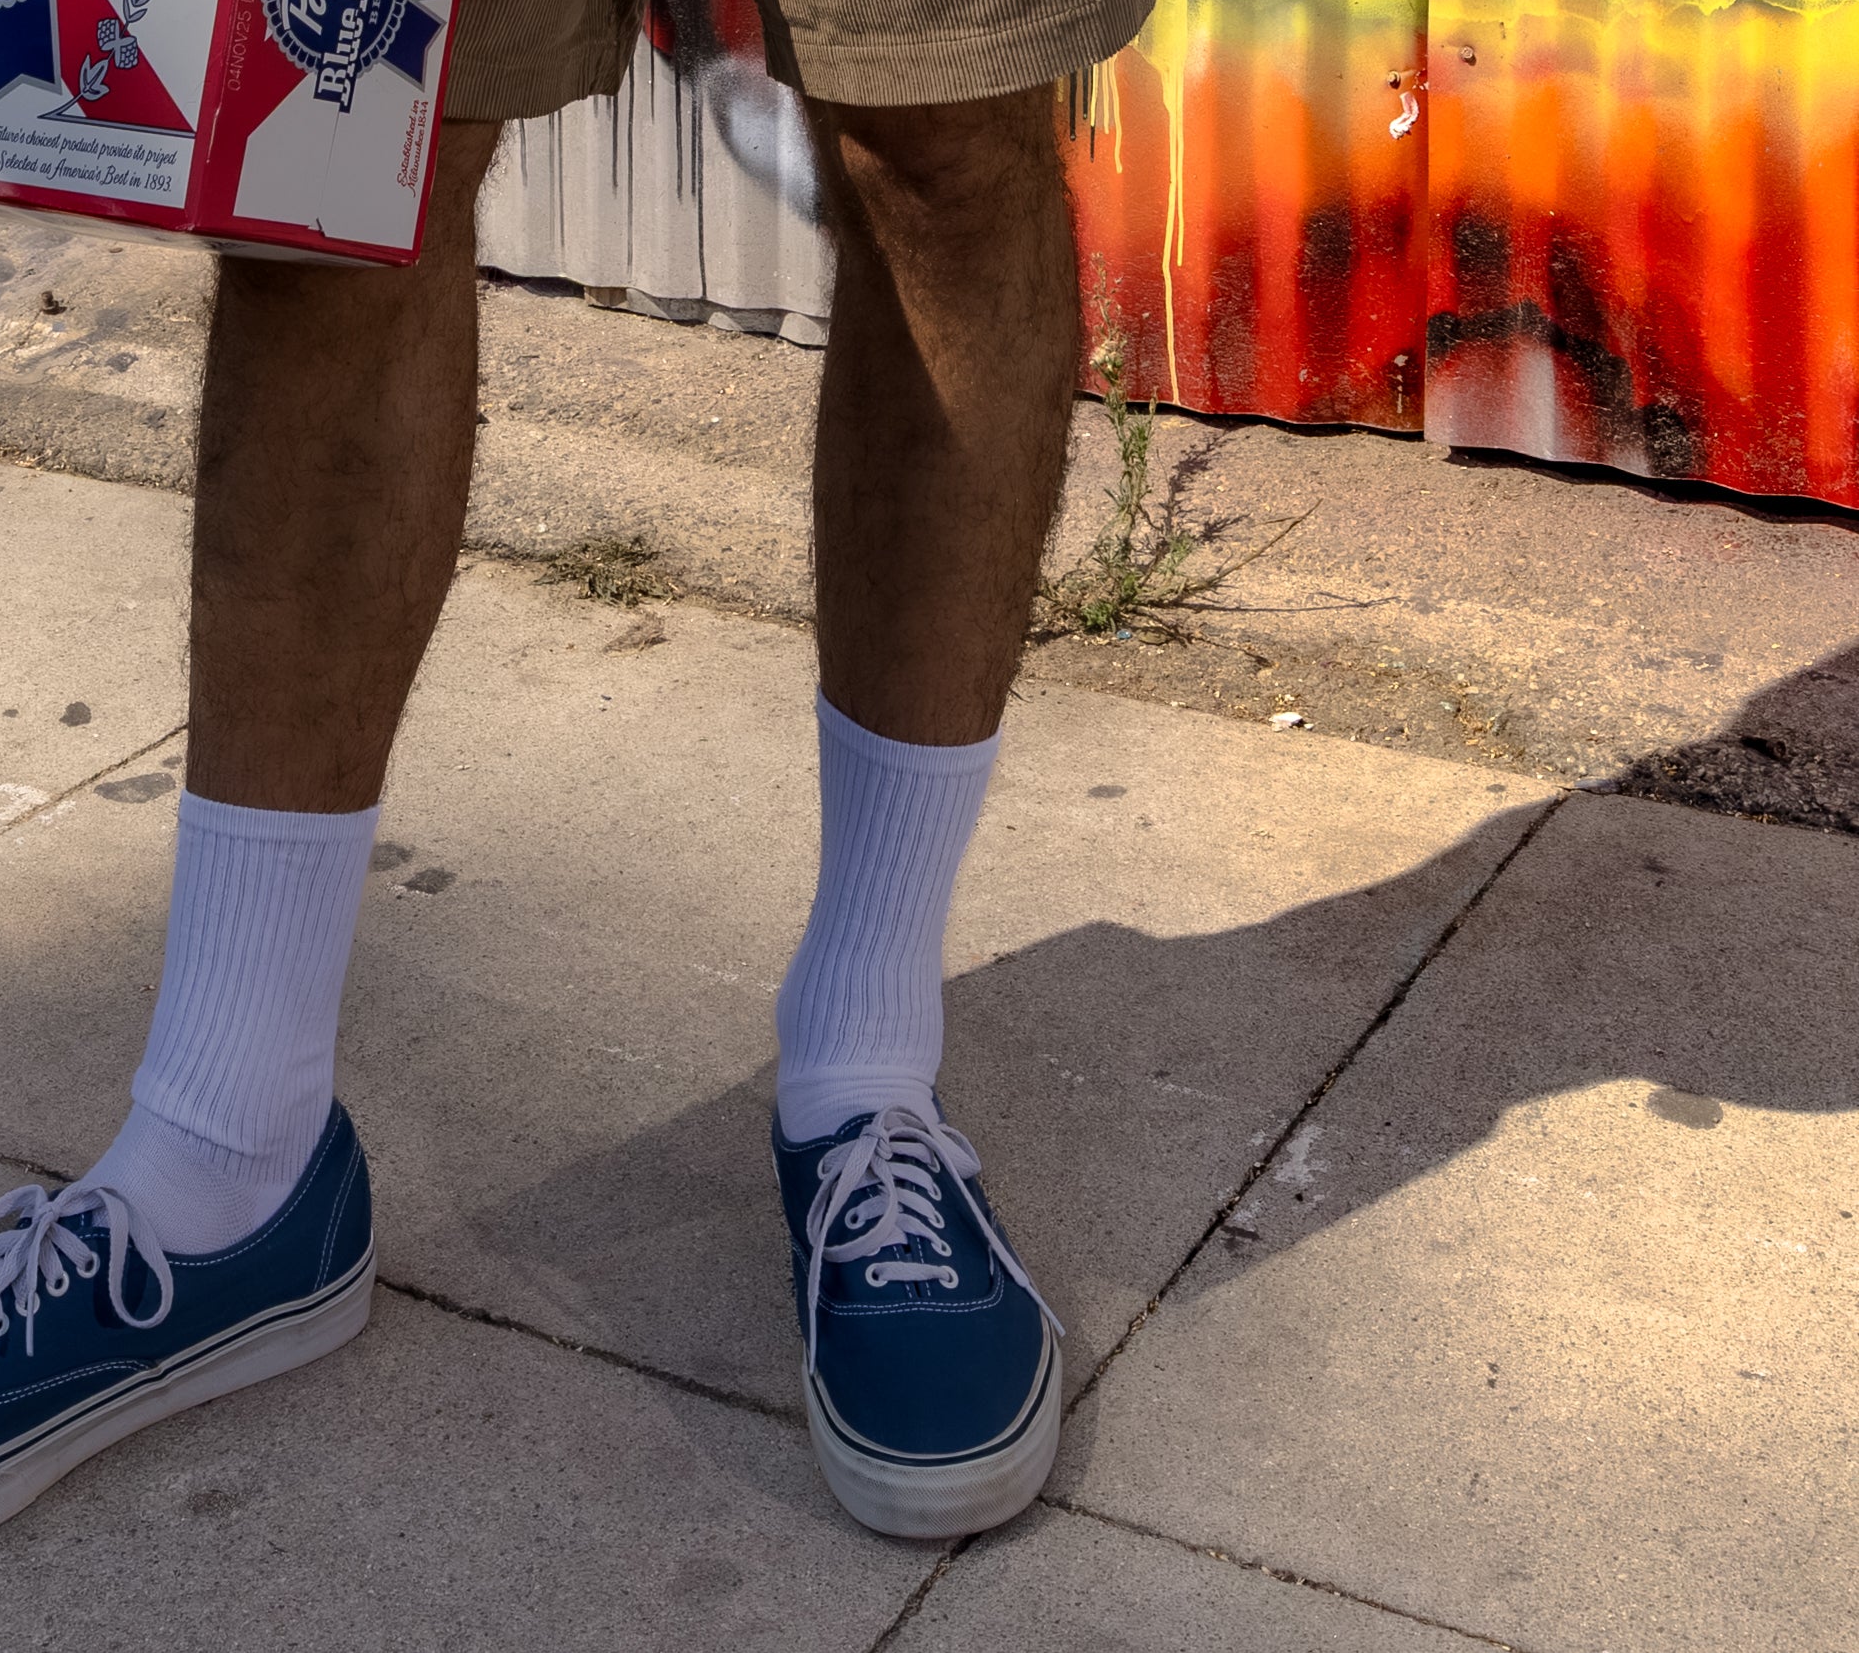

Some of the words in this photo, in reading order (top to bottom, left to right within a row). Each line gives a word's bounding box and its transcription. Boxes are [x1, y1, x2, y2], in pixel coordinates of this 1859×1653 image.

[227, 10, 252, 91] 04NOV25
[317, 8, 364, 108] Blue
[25, 131, 61, 150] choicest
[60, 138, 98, 155] products
[97, 140, 133, 160] provide
[144, 147, 178, 169] prized
[39, 162, 51, 173] as
[48, 158, 101, 182] America's
[100, 165, 128, 186] Best
[128, 173, 141, 188] in
[144, 173, 172, 192] 1893.
[397, 115, 416, 187] Established
[411, 99, 419, 114] in
[407, 129, 424, 198] Milwaukee
[418, 101, 428, 127] 1844
